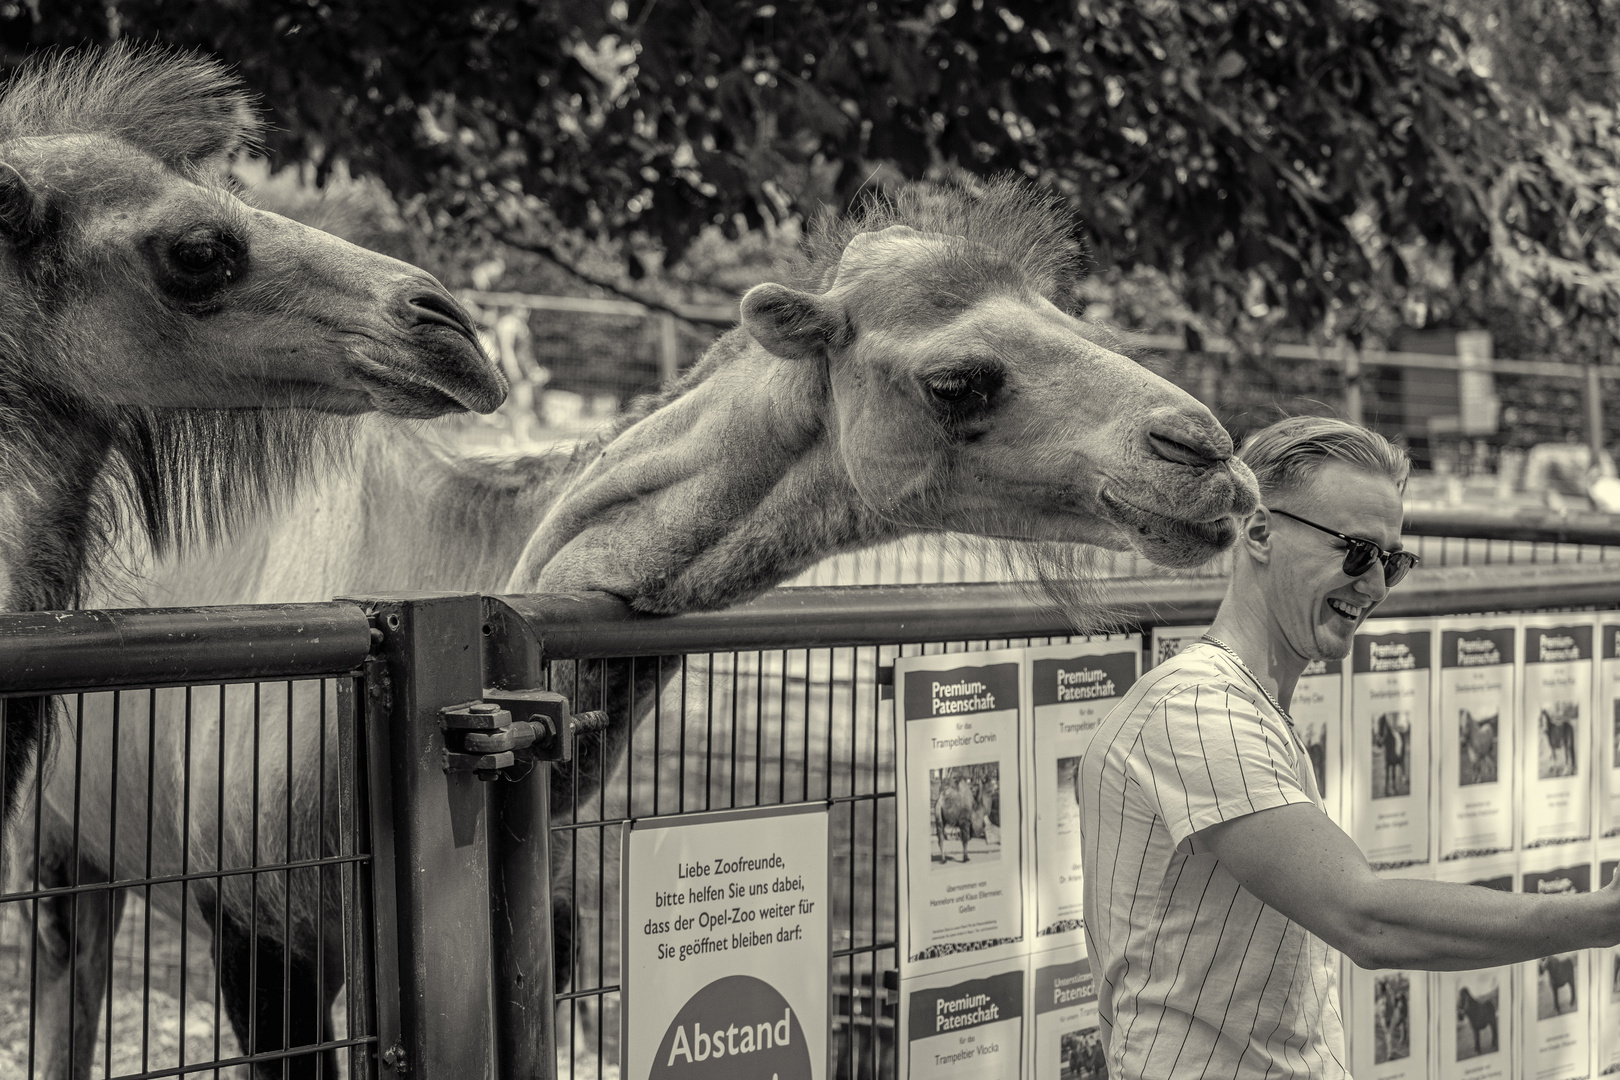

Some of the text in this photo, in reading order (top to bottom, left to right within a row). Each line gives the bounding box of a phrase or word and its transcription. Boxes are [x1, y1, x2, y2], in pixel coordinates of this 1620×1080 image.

[1058, 669, 1106, 684] Premium-
[932, 681, 986, 697] Premium-
[1058, 681, 1115, 701] Patenschaft
[932, 693, 996, 715] Patenschaft
[931, 732, 997, 749] Trampeltier Corvin
[678, 853, 785, 879] Liebe Zoofreunde,
[655, 876, 805, 907] bitte helfen Sie uns dabei,
[644, 899, 815, 935] dass der Opel-Zoo weiter für
[657, 925, 802, 961] Sie geöffnet bleiben darf:
[936, 994, 990, 1014] Premium-
[935, 1004, 1000, 1032] Patenschaft
[667, 1008, 791, 1067] Abstand
[934, 1049, 975, 1066] Trampeltier
